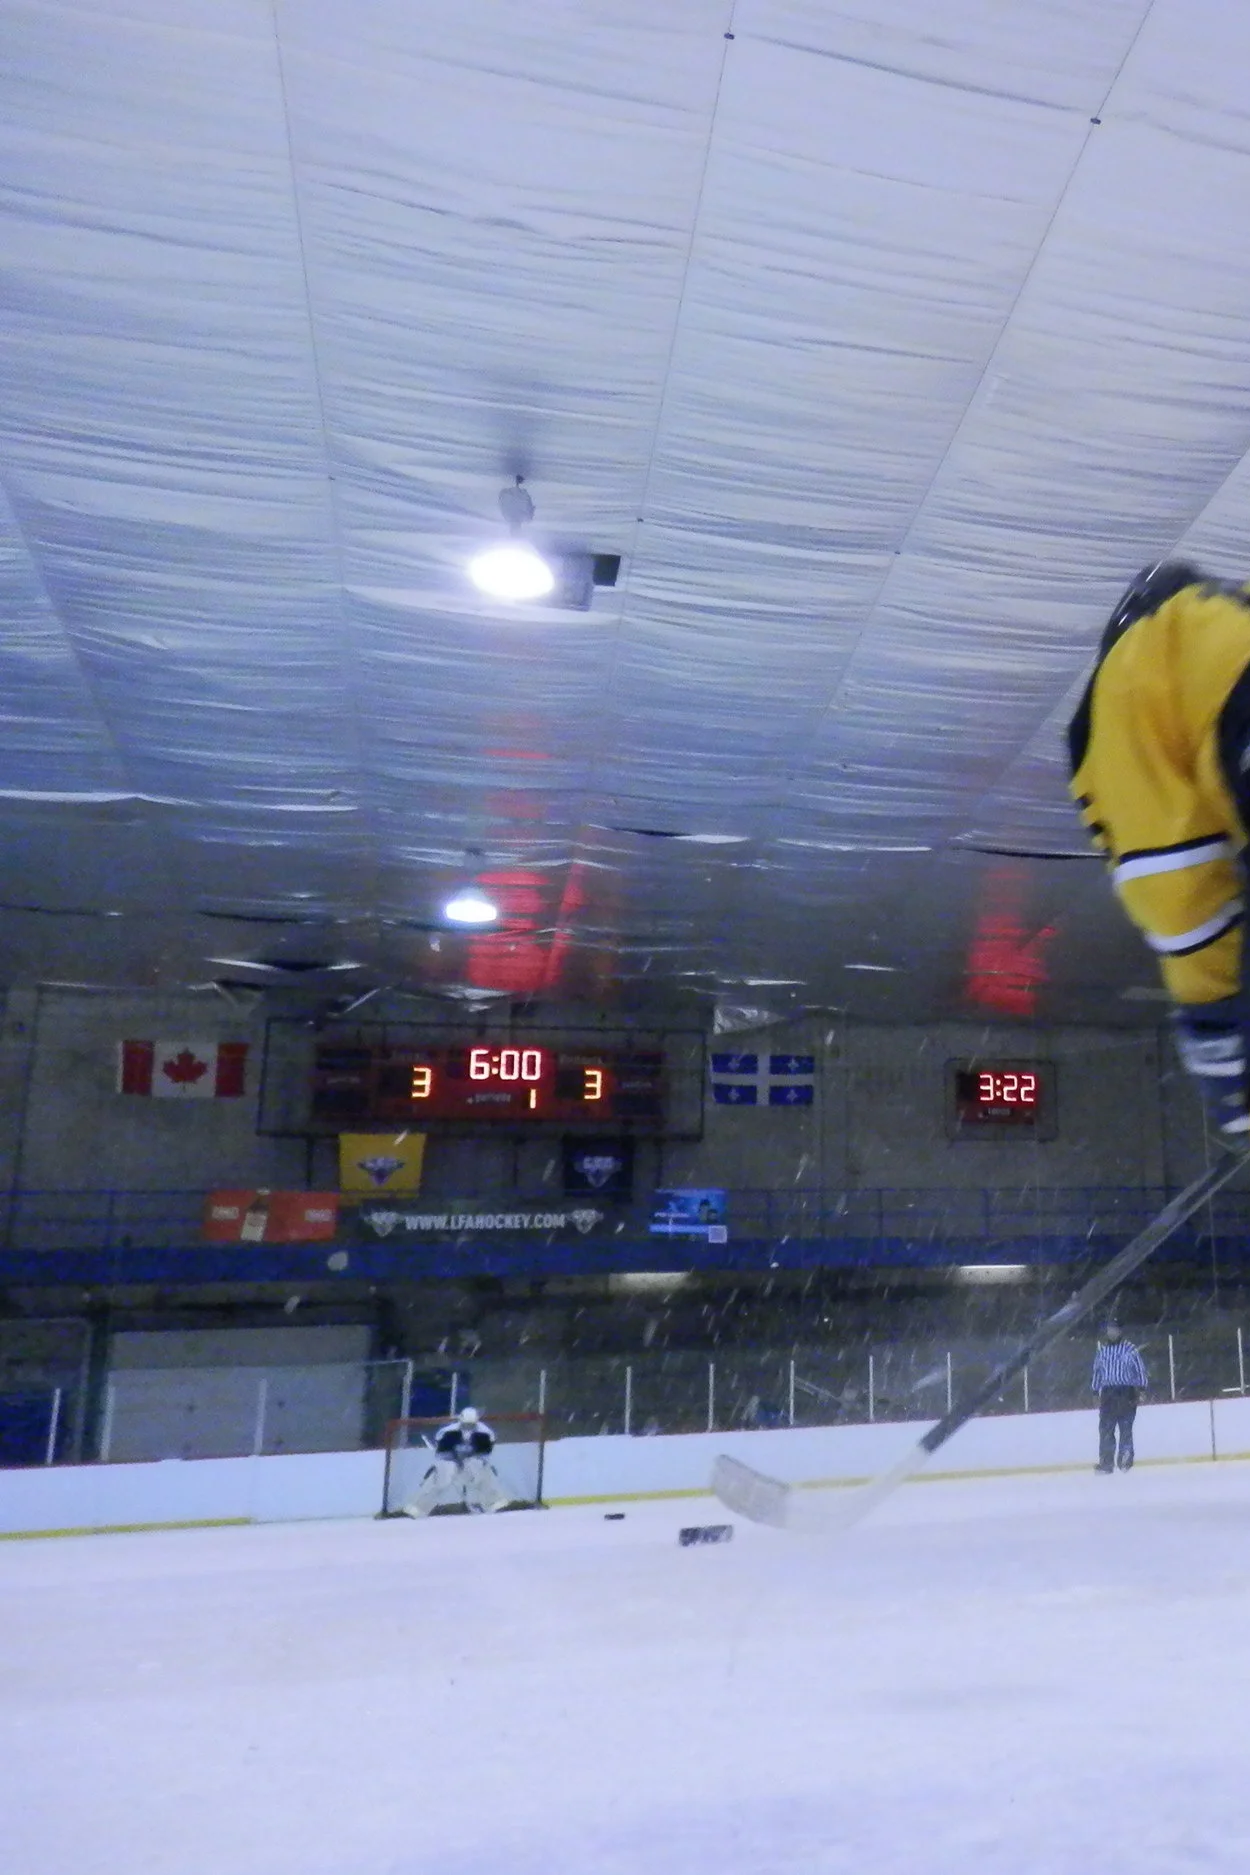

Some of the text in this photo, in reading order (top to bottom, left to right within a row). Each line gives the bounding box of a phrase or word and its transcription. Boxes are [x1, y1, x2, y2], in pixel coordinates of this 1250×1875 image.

[469, 1048, 542, 1081] 6:00
[411, 1066, 432, 1098] 3
[584, 1069, 602, 1100] 3
[979, 1073, 1036, 1102] 3:22
[529, 1088, 537, 1110] 1
[403, 1213, 566, 1231] WWW.LFAHOCKEY.COM
